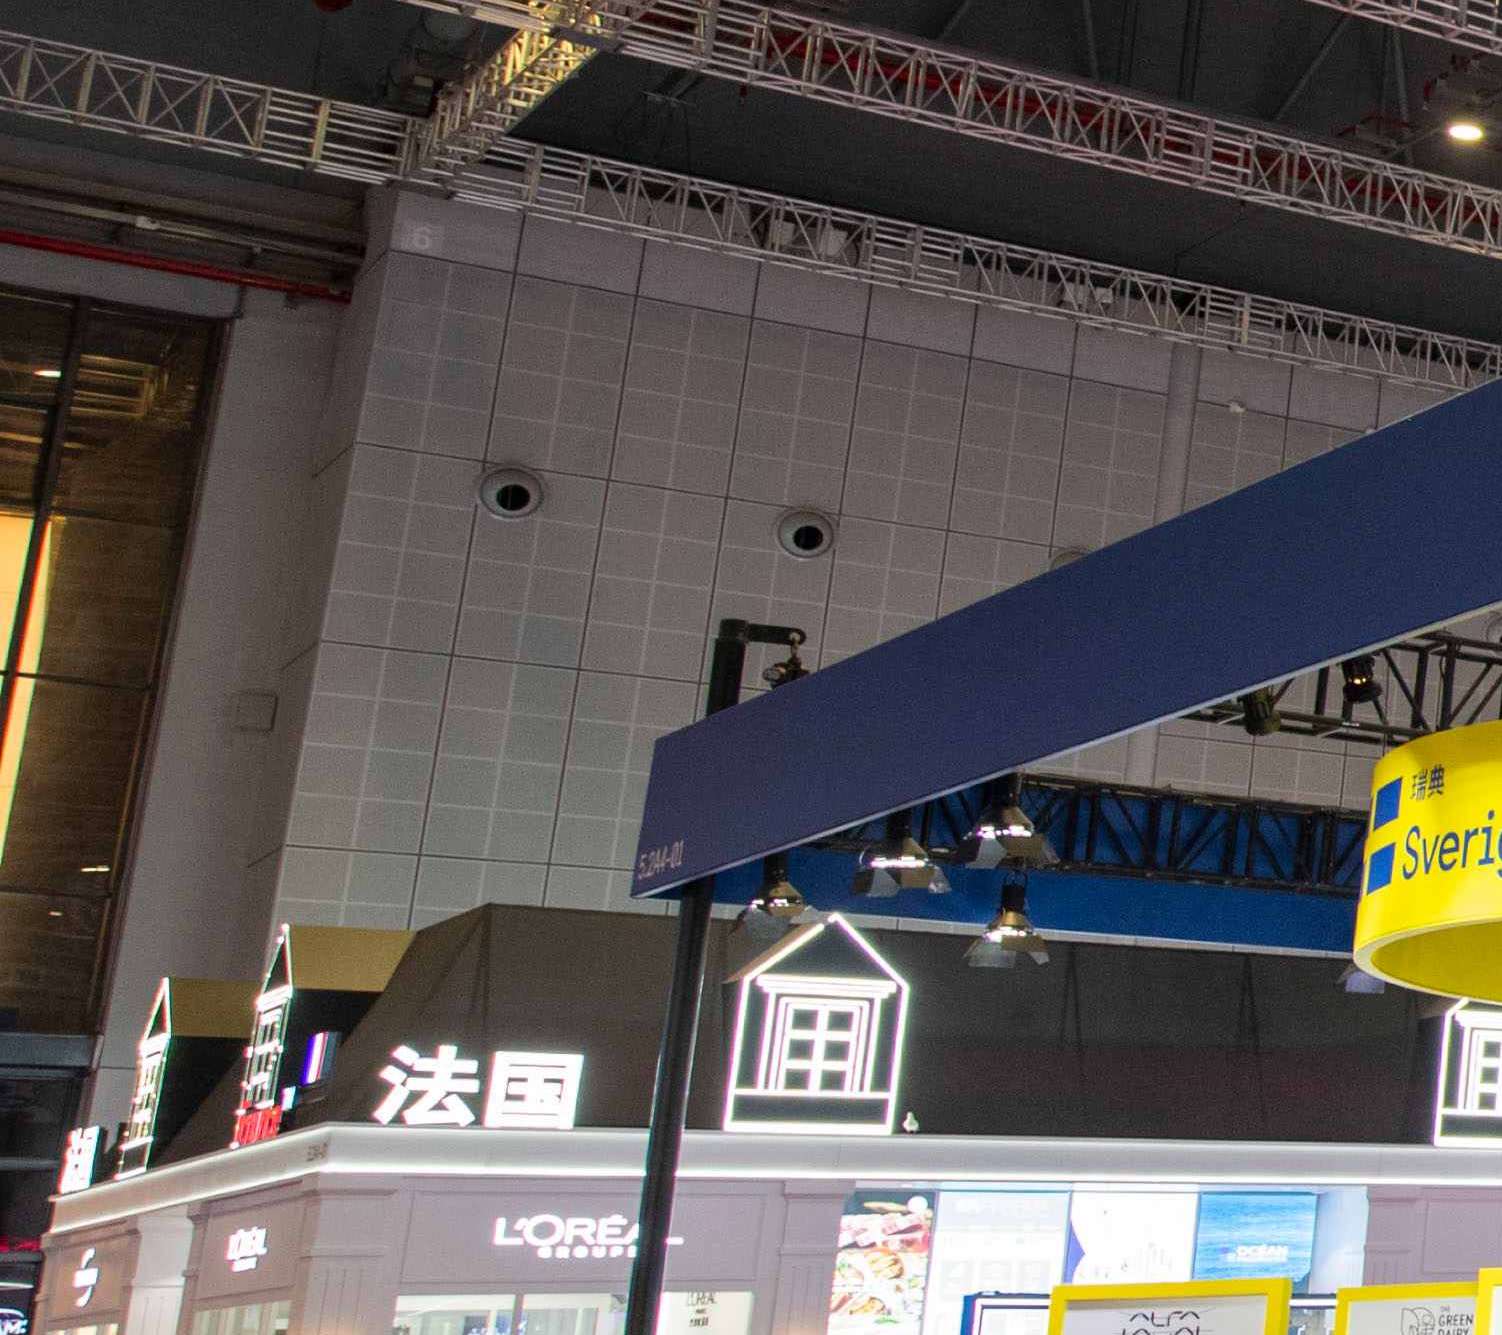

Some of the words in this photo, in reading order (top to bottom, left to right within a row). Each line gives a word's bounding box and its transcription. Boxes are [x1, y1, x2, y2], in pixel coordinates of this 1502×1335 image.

[1410, 764, 1445, 802] 瑞典
[373, 1045, 585, 1129] 法国
[1438, 1313, 1473, 1327] GREEN
